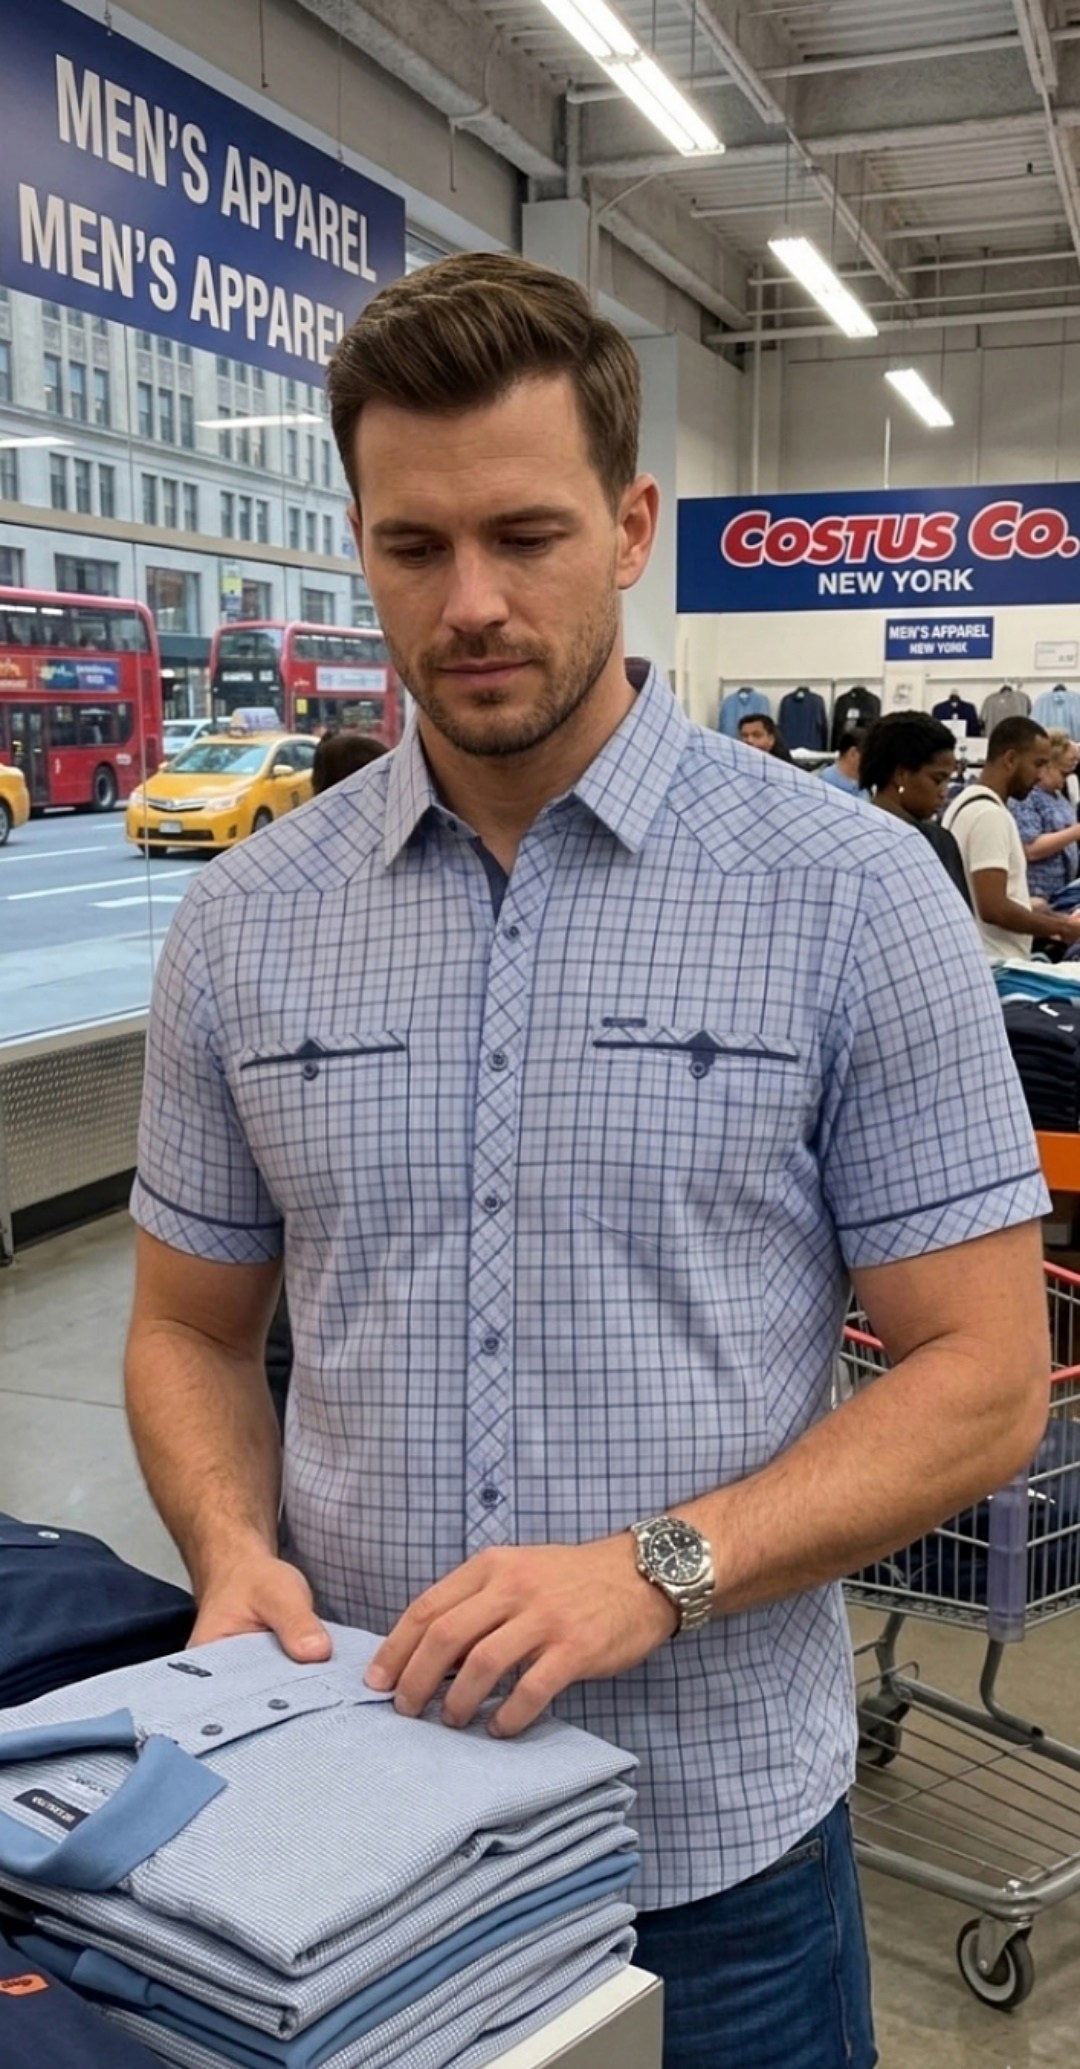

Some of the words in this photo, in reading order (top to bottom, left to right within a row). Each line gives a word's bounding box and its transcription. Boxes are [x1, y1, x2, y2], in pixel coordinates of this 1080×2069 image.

[56, 53, 209, 204] MEN'S
[221, 145, 376, 283] APPAREL
[19, 183, 177, 311] MEN'S
[818, 571, 884, 596] NEW
[891, 568, 974, 593] YORK
